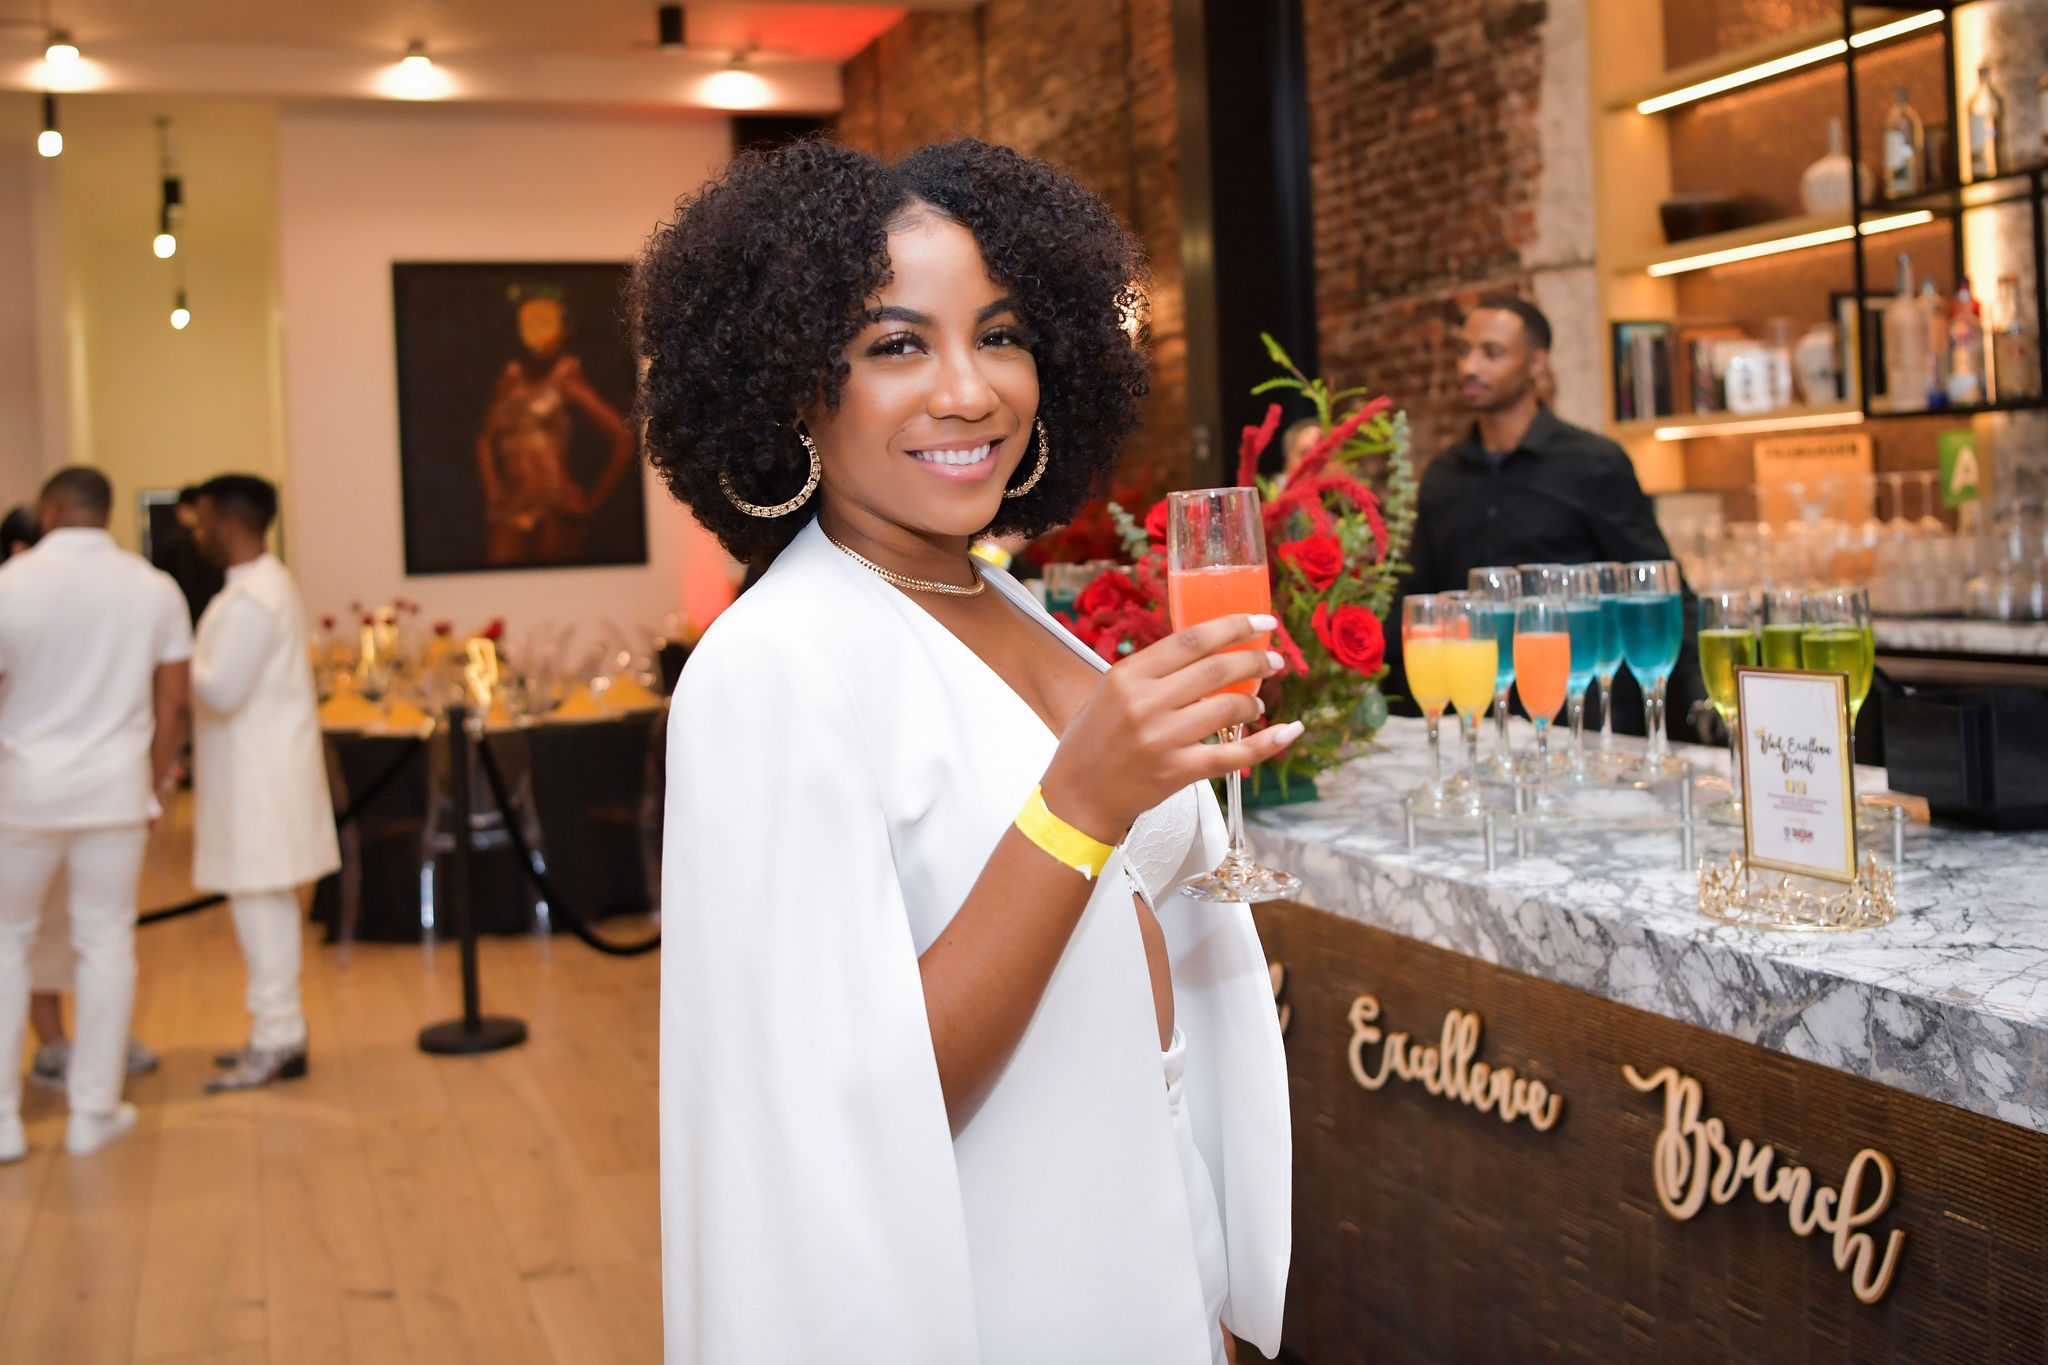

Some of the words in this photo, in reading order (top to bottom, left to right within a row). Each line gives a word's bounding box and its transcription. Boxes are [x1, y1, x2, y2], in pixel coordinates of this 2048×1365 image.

[1951, 446, 1980, 495] A
[1348, 994, 1562, 1132] Excellence
[1622, 1064, 1905, 1304] Brunch
